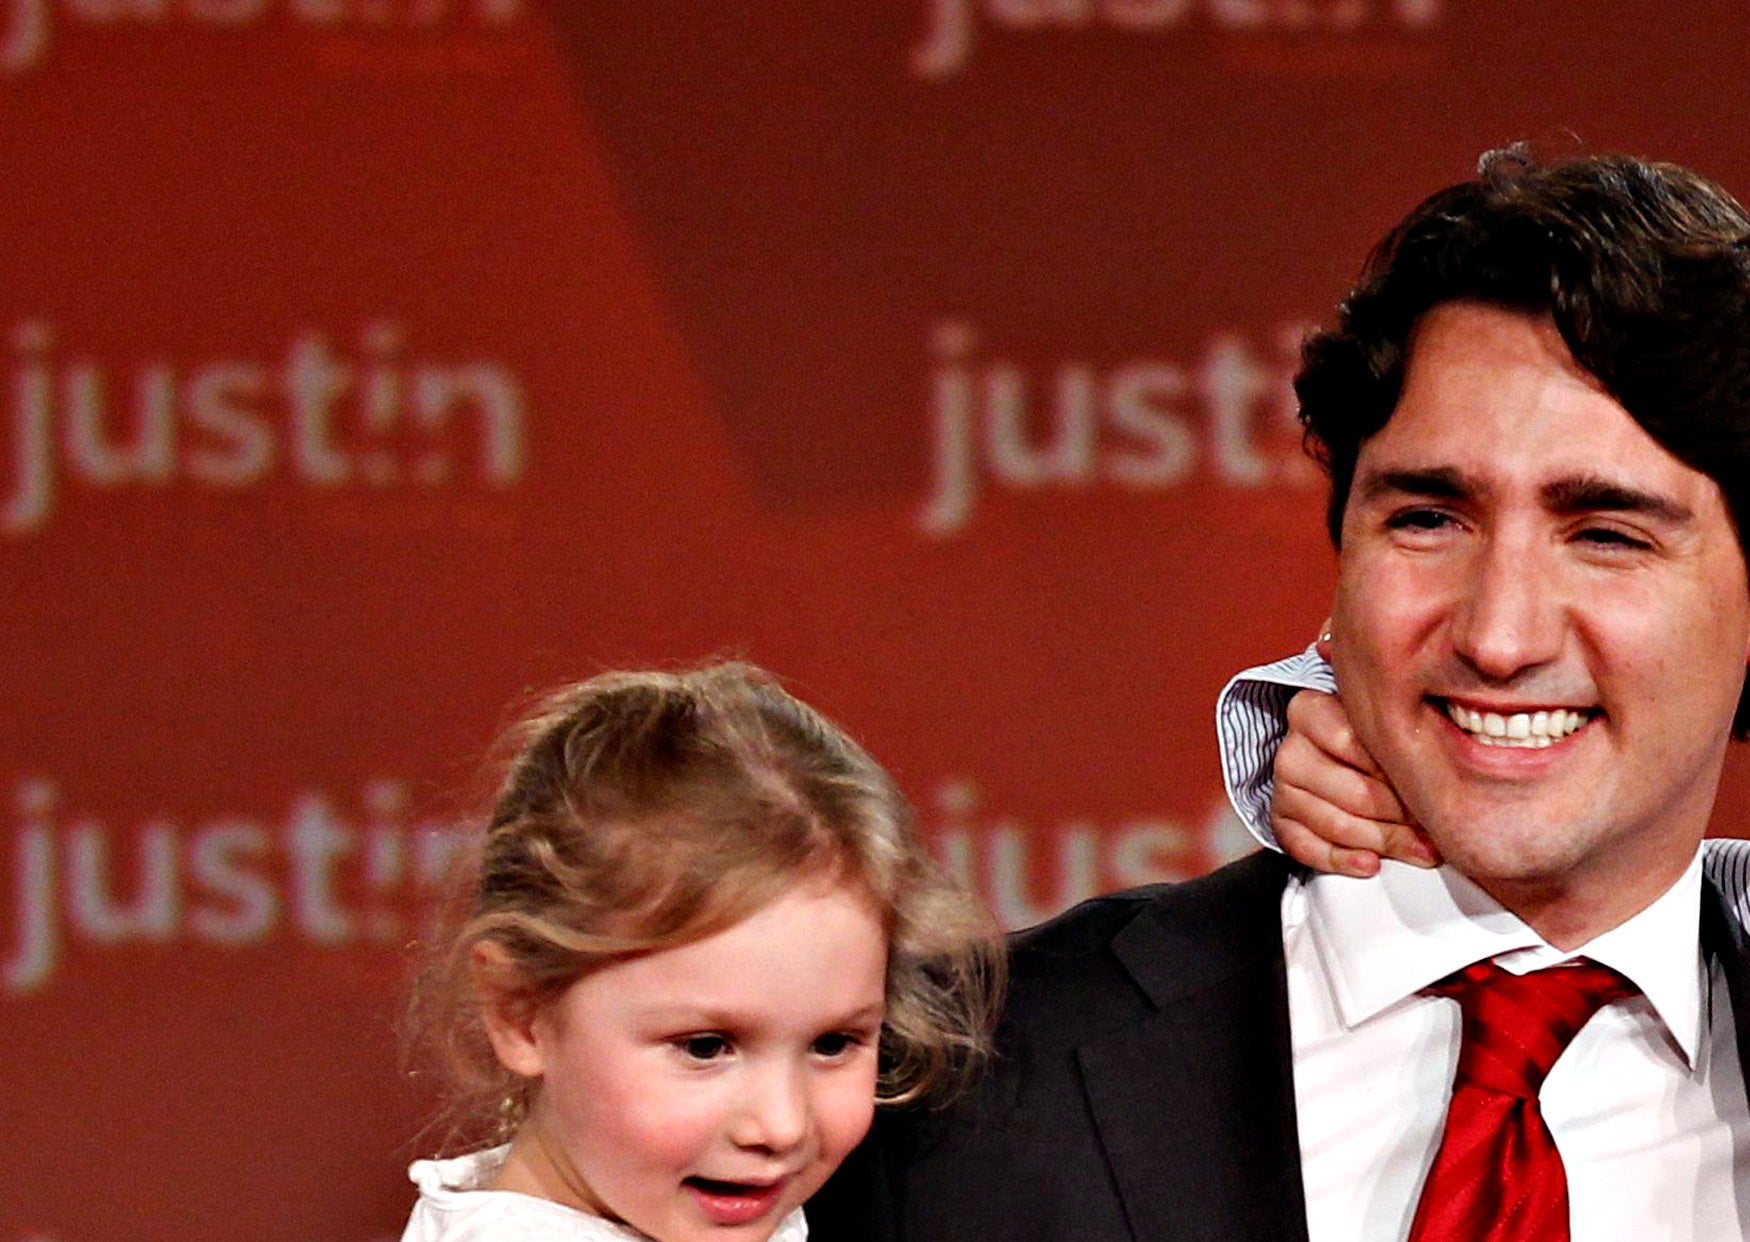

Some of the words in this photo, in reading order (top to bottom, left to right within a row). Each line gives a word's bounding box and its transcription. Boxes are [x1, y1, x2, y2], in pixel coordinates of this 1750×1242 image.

[4, 321, 524, 533] justin
[919, 319, 1318, 534] justi
[8, 781, 486, 994] justi
